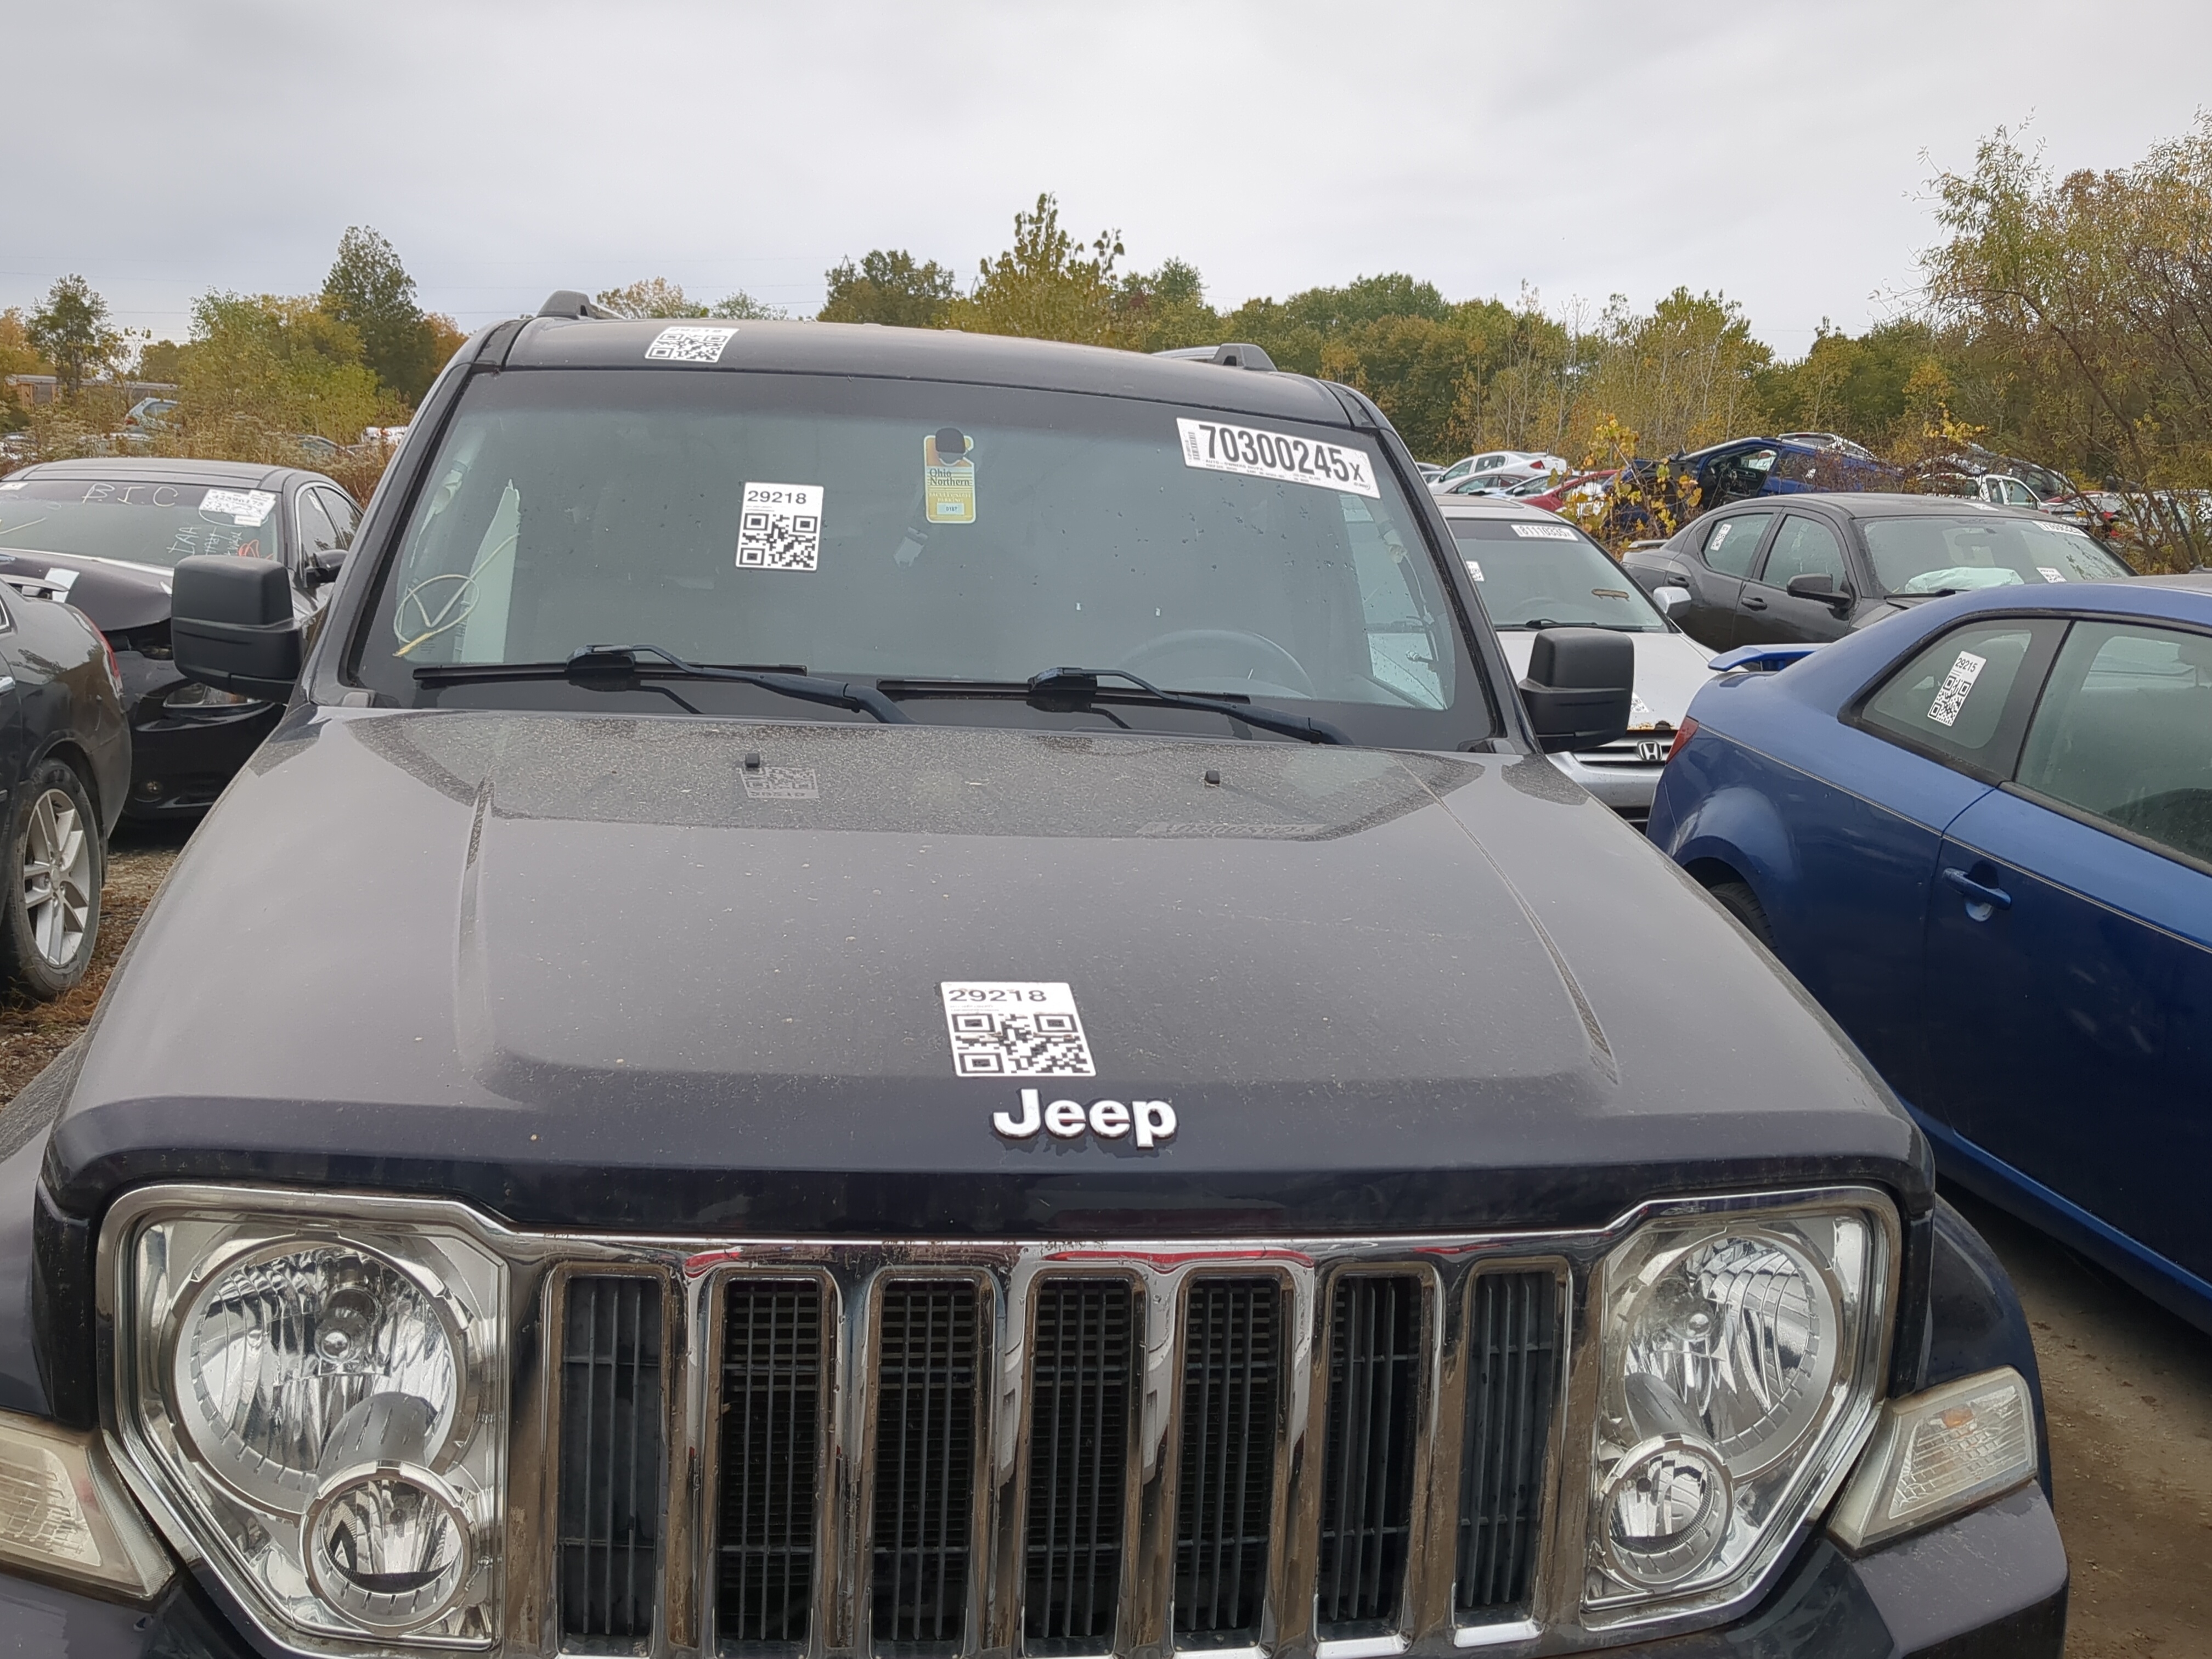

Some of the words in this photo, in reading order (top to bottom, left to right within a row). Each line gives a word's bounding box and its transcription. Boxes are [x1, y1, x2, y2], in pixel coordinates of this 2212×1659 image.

[929, 469, 952, 477] Ohio
[929, 477, 970, 486] Northern
[747, 490, 806, 505] 29218
[1955, 657, 1978, 673] 29215
[949, 990, 1047, 1002] 29218
[993, 1088, 1177, 1148] Jeep
